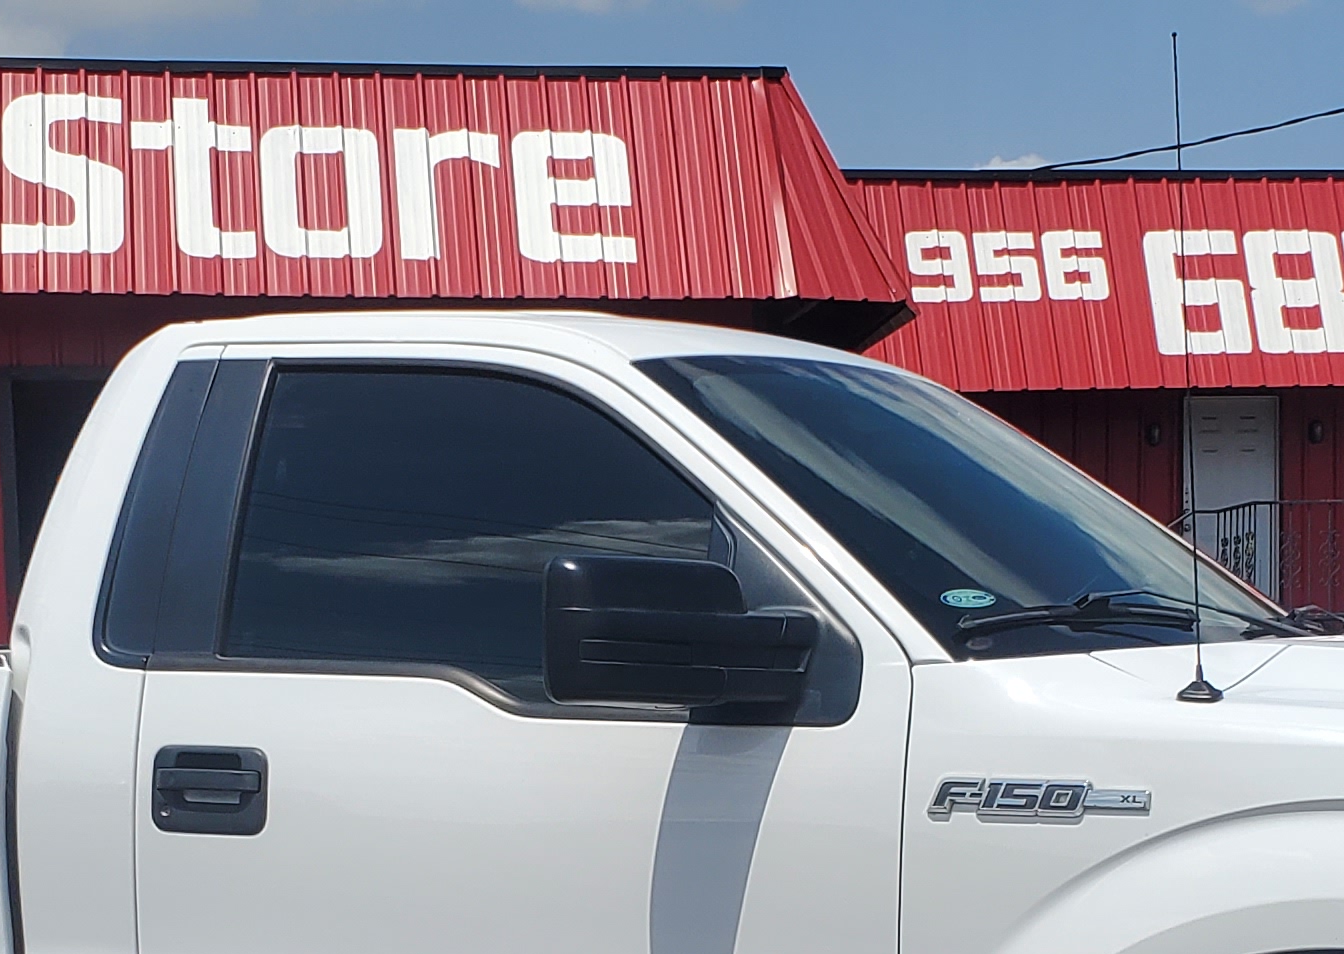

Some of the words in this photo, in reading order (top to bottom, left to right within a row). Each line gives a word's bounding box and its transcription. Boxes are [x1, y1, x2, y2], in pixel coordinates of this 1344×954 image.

[0, 92, 638, 264] Store
[904, 229, 1109, 303] 956
[927, 777, 1093, 822] F-150
[1119, 793, 1143, 805] XL
